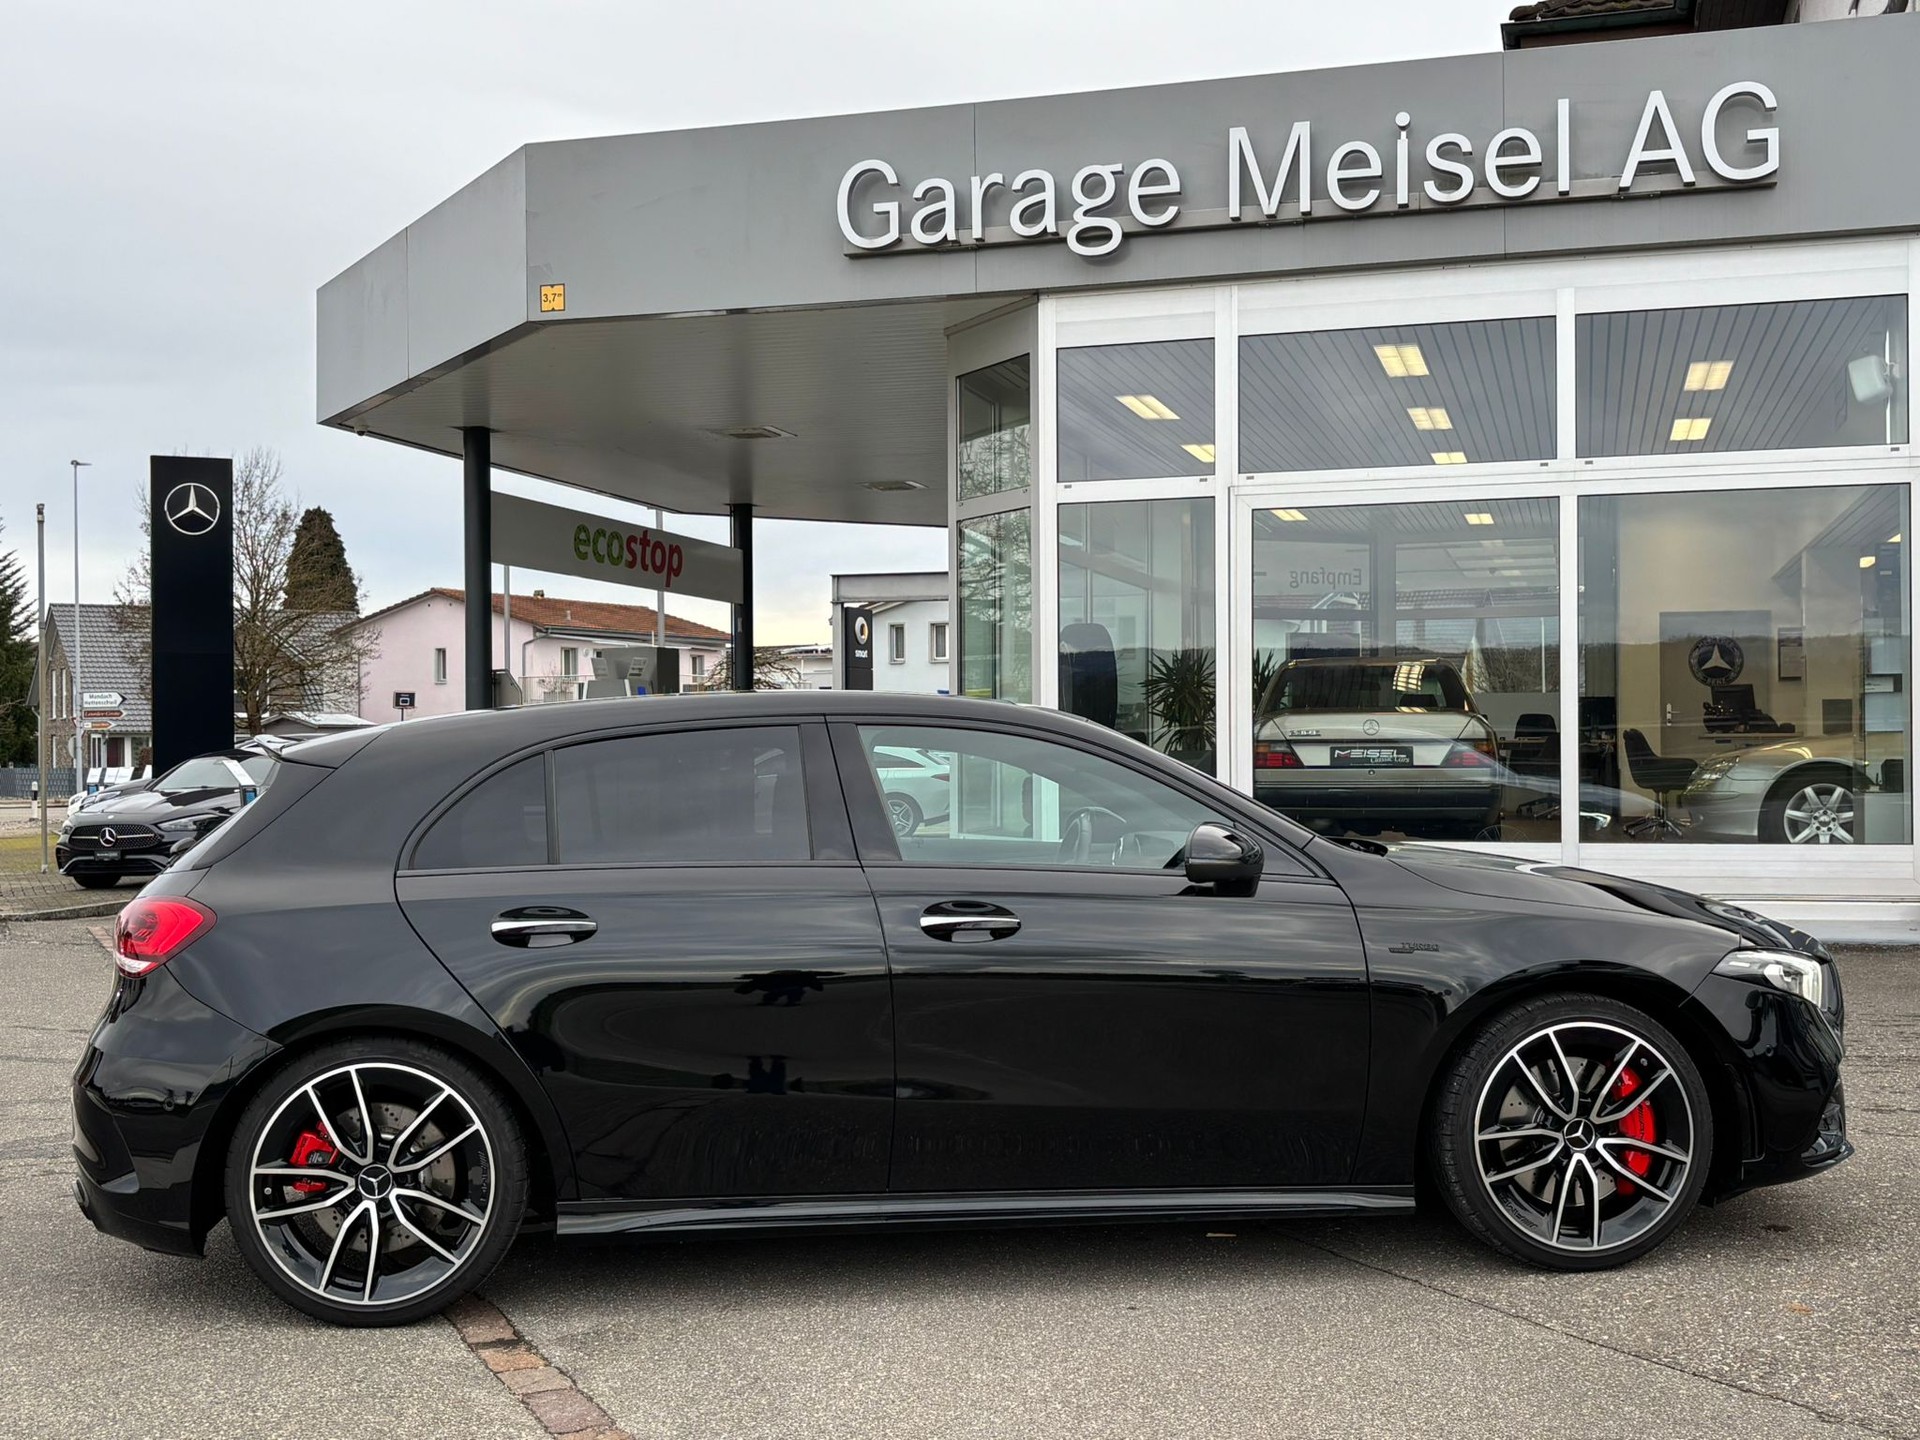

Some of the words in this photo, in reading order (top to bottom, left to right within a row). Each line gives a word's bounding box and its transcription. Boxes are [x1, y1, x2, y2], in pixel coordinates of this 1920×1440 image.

[837, 158, 1181, 256] Garage
[1229, 111, 1570, 221] Meisel
[1619, 80, 1780, 190] AG
[573, 523, 683, 588] ecostop
[854, 649, 868, 658] smart
[1334, 749, 1407, 758] MEISEL
